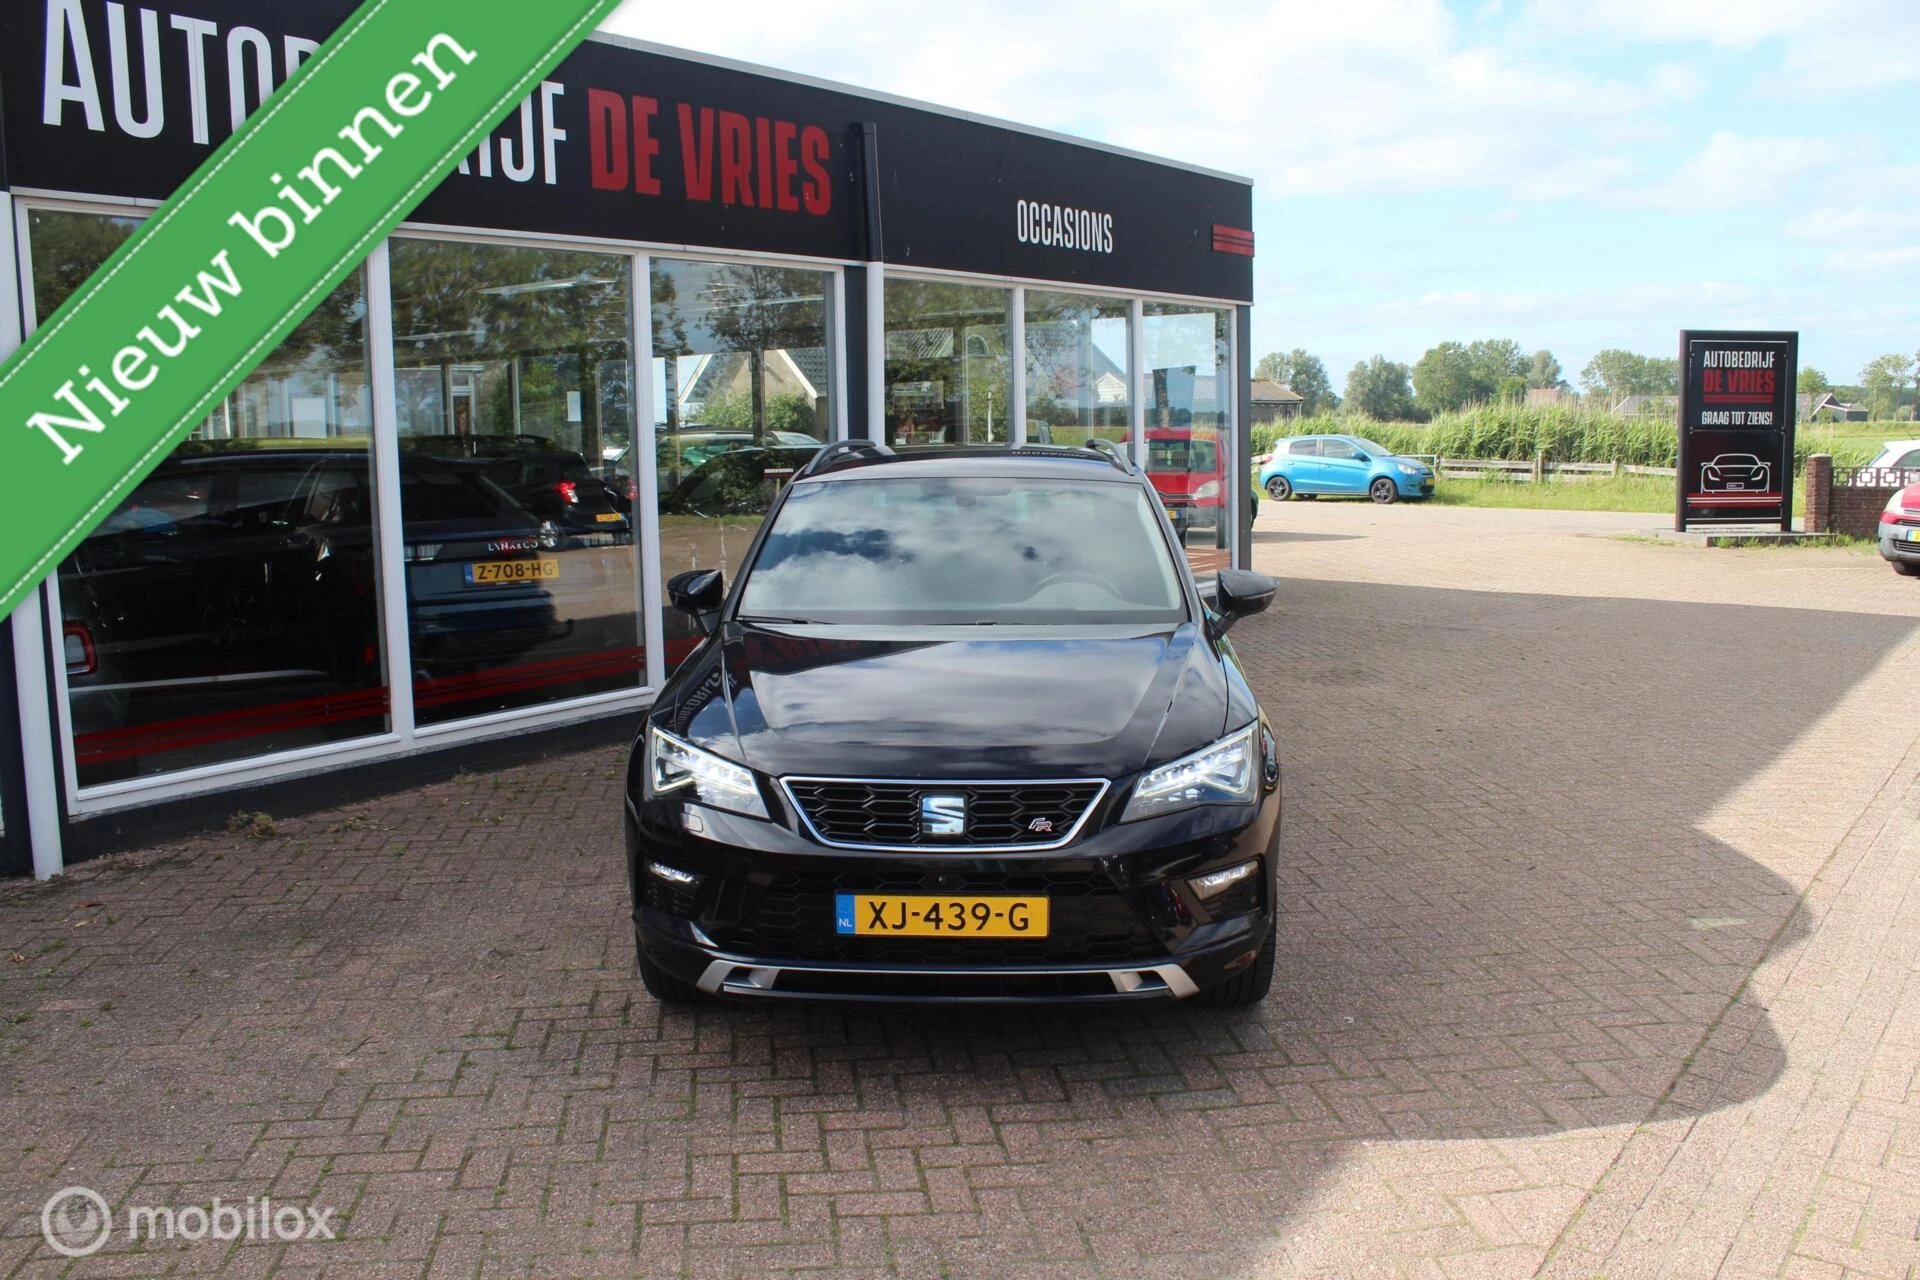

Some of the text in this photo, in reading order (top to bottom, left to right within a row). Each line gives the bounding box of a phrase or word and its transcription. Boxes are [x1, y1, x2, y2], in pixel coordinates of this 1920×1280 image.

[43, 0, 832, 216] AUTOJF DE VRIES
[1017, 199, 1113, 254] OCCASIONS
[1703, 350, 1776, 368] AUTOBEDRIJF
[1703, 369, 1776, 393] DE VRIES
[1701, 411, 1774, 425] GRAAG TOT ZIENS!
[839, 918, 853, 927] NL
[868, 901, 1029, 931] XJ-439-G
